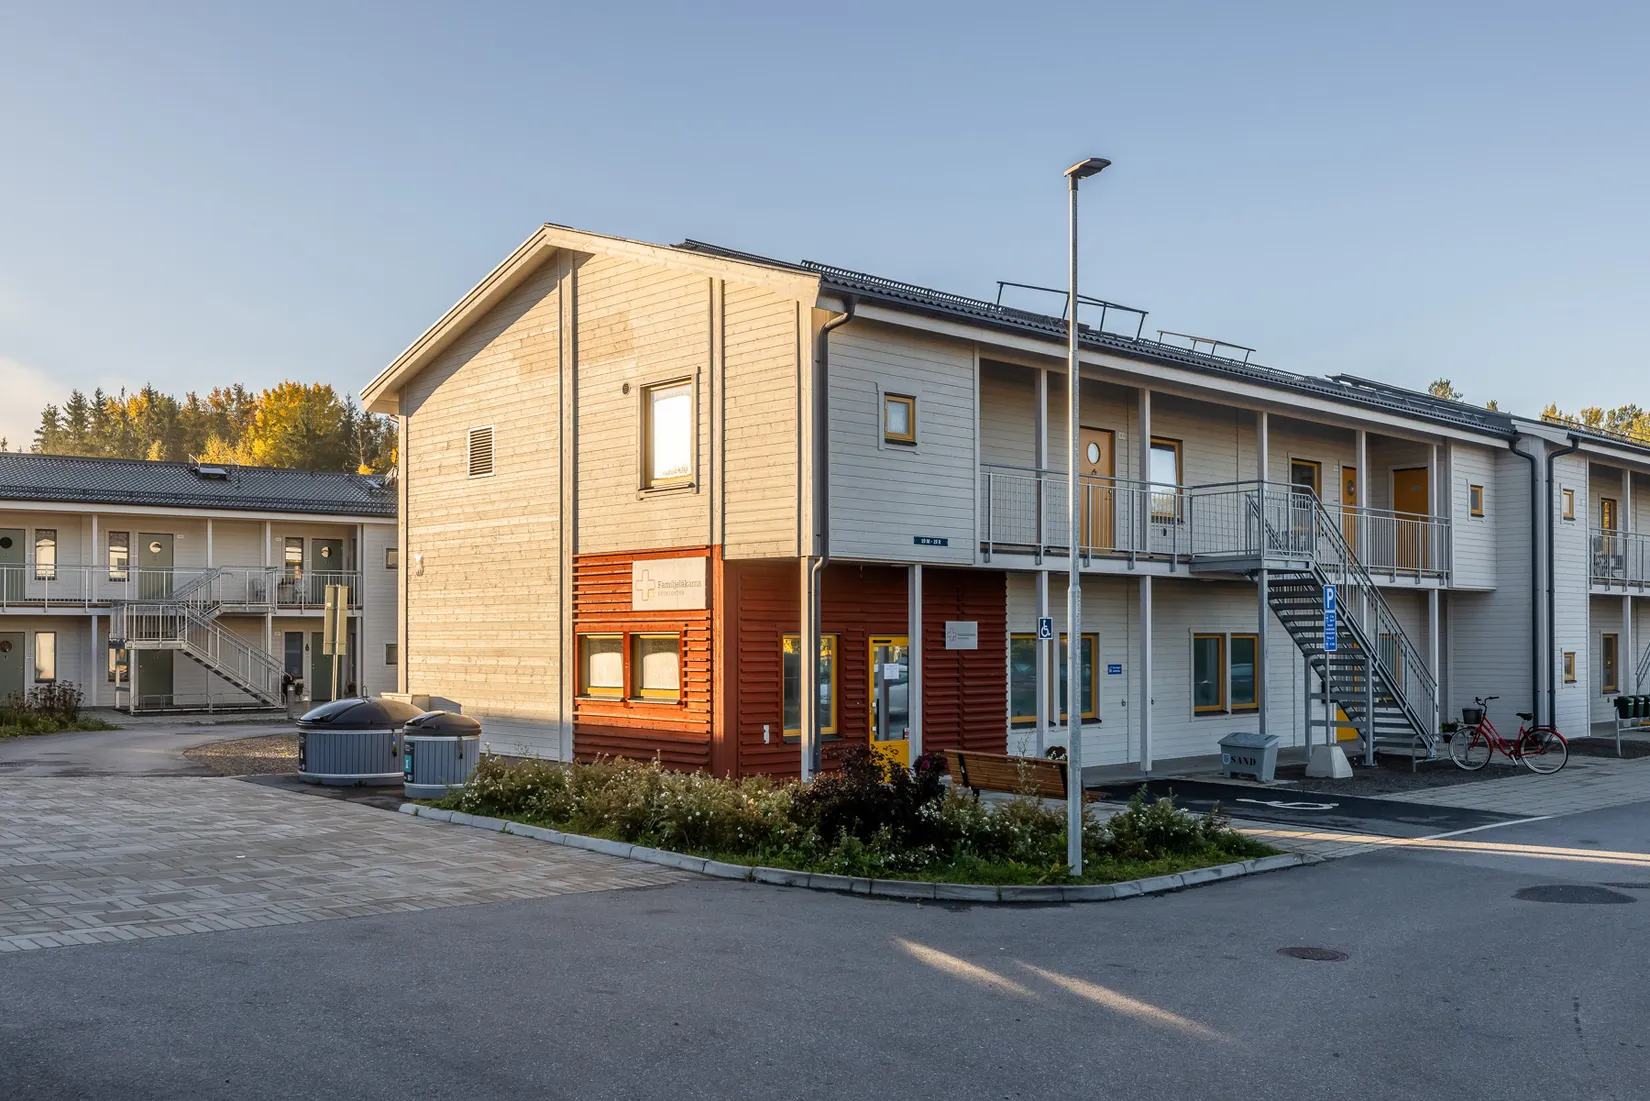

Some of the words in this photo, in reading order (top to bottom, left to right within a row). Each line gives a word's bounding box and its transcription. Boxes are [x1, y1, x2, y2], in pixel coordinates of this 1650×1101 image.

[657, 580, 702, 589] Familjeläkarna
[1327, 587, 1334, 609] P
[1230, 755, 1257, 766] SAND
